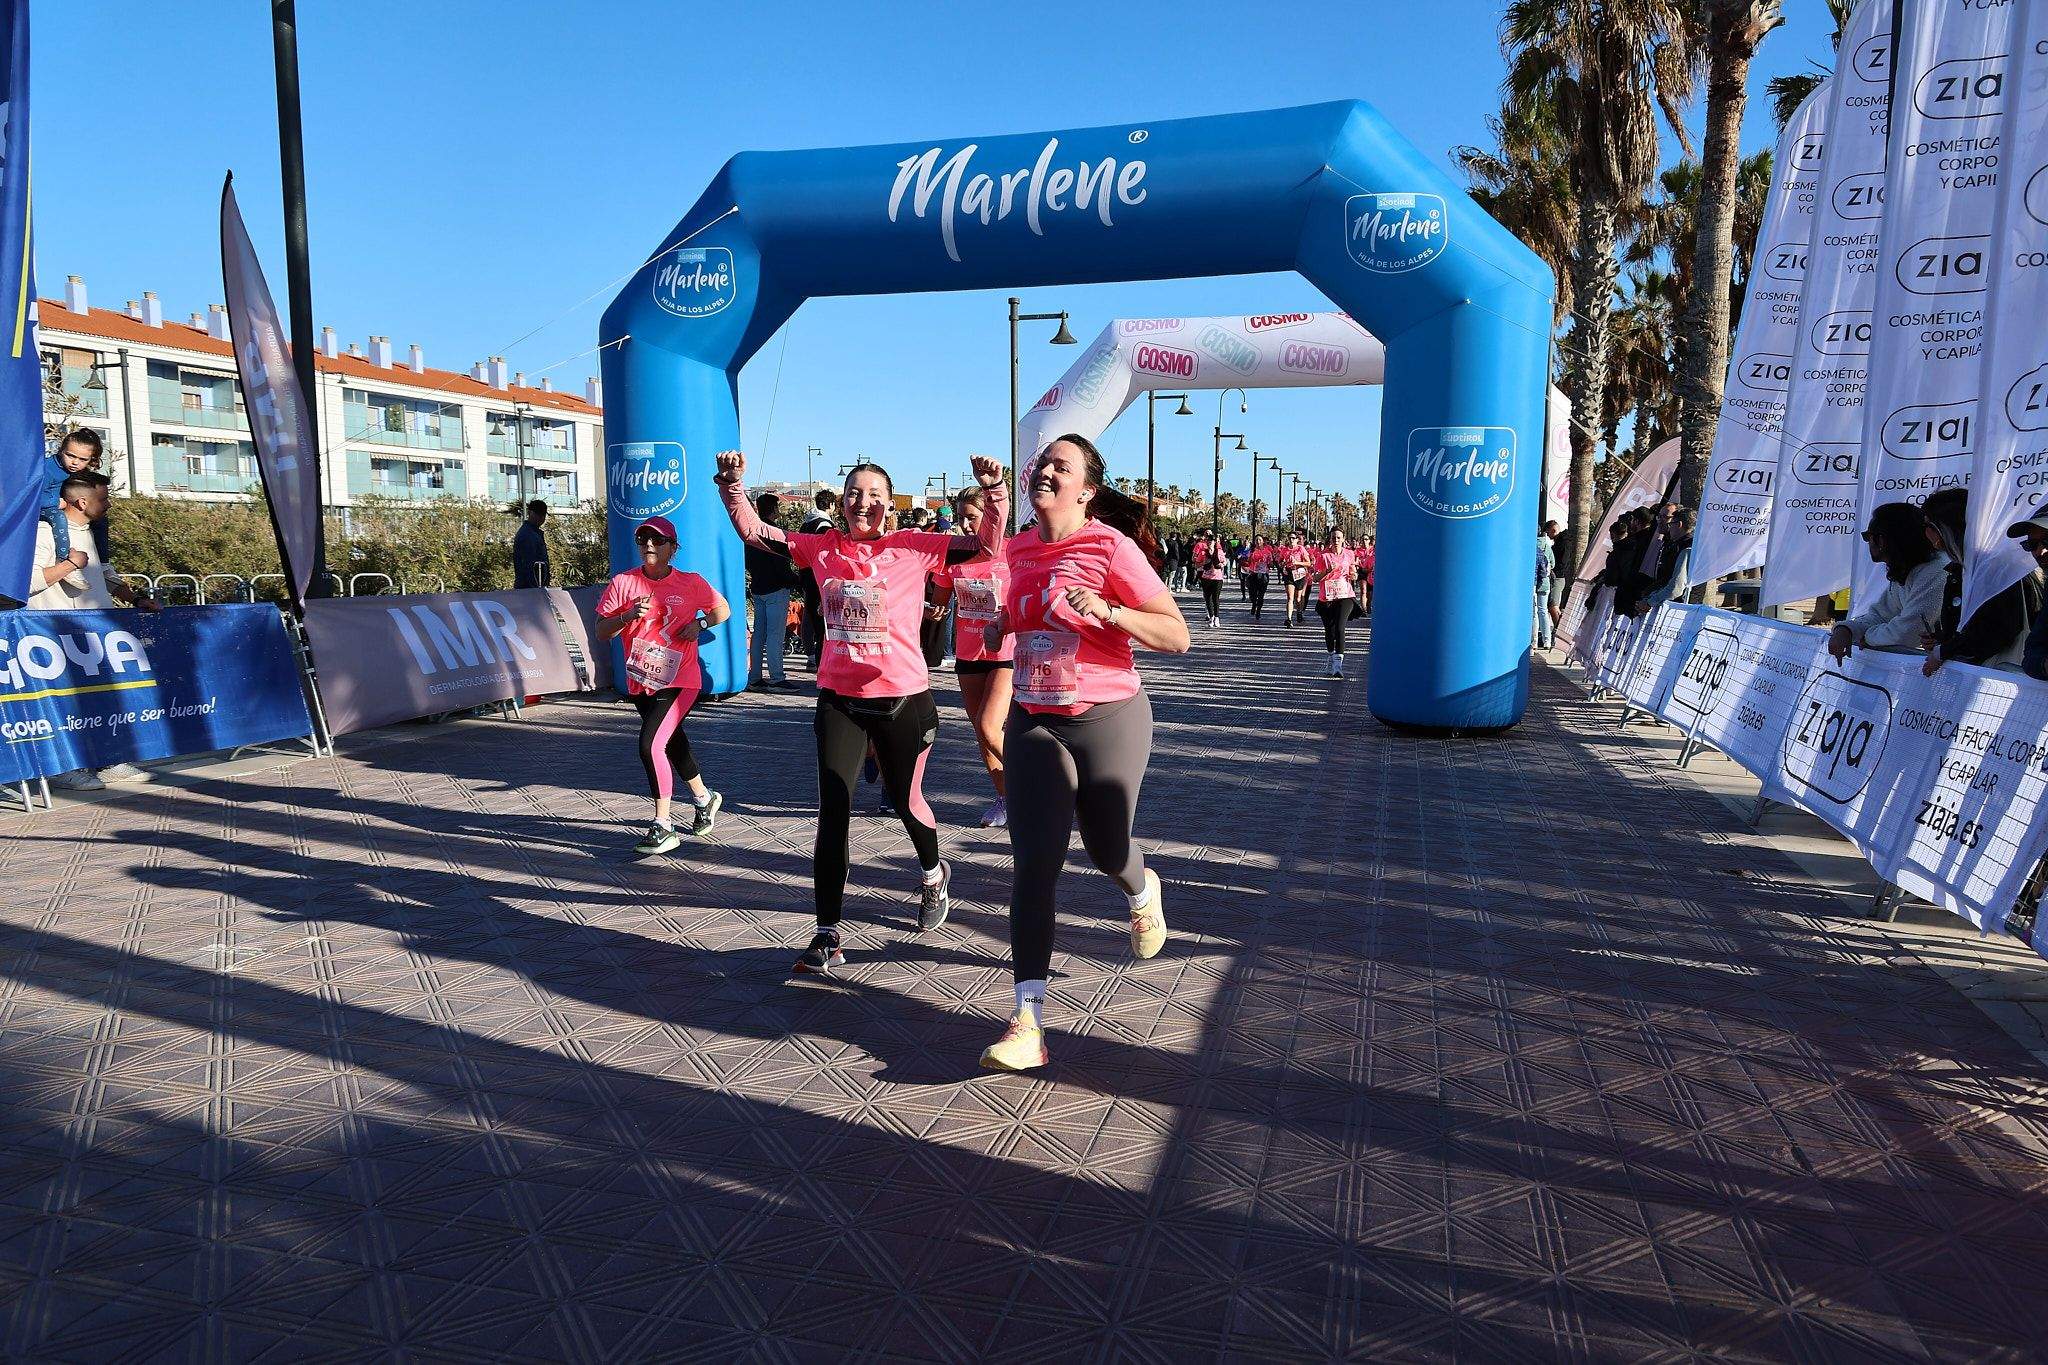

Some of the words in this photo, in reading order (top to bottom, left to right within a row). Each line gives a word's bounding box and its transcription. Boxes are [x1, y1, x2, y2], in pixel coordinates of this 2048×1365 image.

[1940, 177, 1950, 189] Y
[888, 137, 1147, 262] Marlene
[1352, 210, 1441, 253] Marlene
[1358, 252, 1374, 266] HIJA
[1376, 260, 1387, 268] DE
[1389, 260, 1406, 268] LOS
[1408, 247, 1434, 266] ALPES
[658, 263, 729, 298] Marlene
[660, 296, 675, 310] HIJA
[676, 305, 687, 313] DE
[704, 297, 725, 312] ALPES
[1250, 314, 1308, 330] COSMO
[1889, 309, 1981, 328] COSMÉTICA
[1201, 328, 1257, 371] COSMO
[1284, 343, 1344, 373] COSMO
[1922, 348, 1933, 361] Y
[1137, 346, 1193, 377] COSMO
[1729, 398, 1785, 411] COSMÉTICA
[1826, 397, 1834, 407] Y
[611, 459, 680, 499] Marlene
[1413, 447, 1509, 493] Marlene
[1875, 474, 1960, 491] COSMÉTICA
[625, 507, 634, 515] DE
[635, 507, 650, 515] LOS
[651, 497, 675, 513] ALPES
[1416, 491, 1434, 508] HIJA
[1436, 502, 1449, 512] DE
[1451, 505, 1470, 513] LOS
[1472, 493, 1500, 511] ALPES
[1706, 502, 1760, 515] COSMÉTICA
[1785, 497, 1851, 509] COSMÉTICA
[1805, 512, 1856, 522] CORPOR
[1806, 525, 1814, 535] Y
[843, 607, 869, 619] 016
[386, 600, 537, 675] IMR
[643, 662, 662, 674] 016
[1, 719, 53, 740] GOYA
[108, 710, 136, 736] que
[140, 708, 166, 722] ser
[170, 696, 217, 718] bueno!
[1899, 708, 1959, 742] COSMÉTICA
[1797, 700, 1873, 780] ziaja
[1937, 756, 1946, 773] Y
[1947, 760, 1999, 795] CAPILAR
[1914, 795, 1984, 849] ziaja.es
